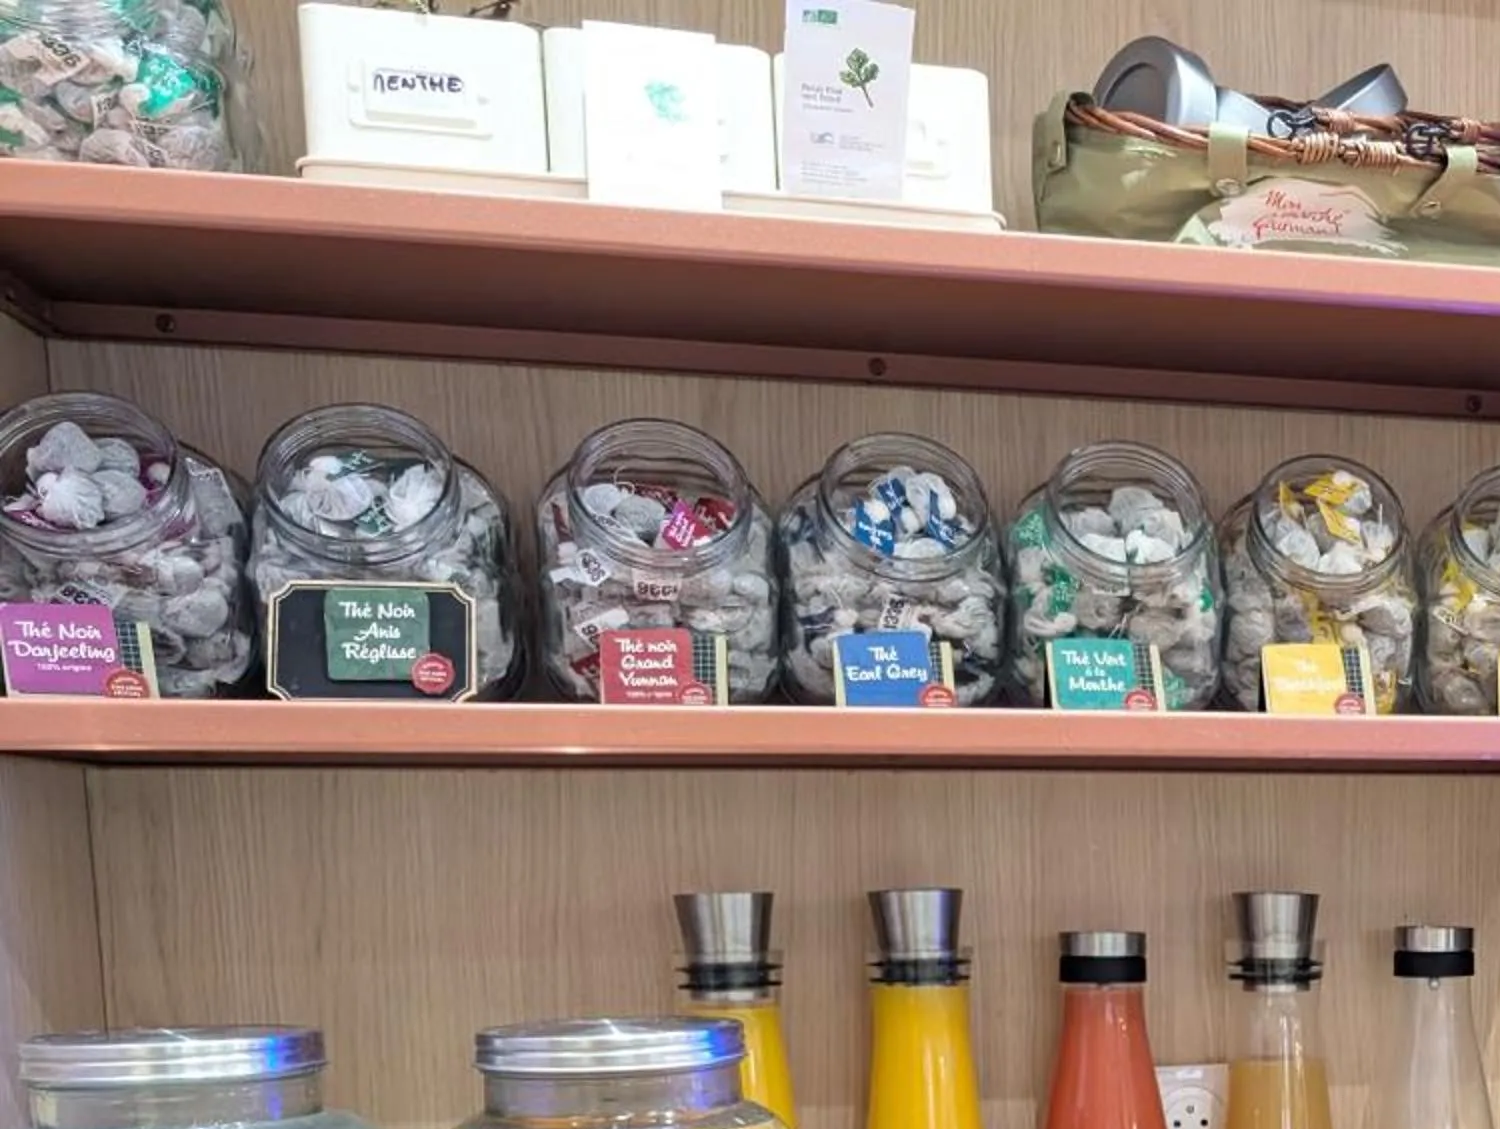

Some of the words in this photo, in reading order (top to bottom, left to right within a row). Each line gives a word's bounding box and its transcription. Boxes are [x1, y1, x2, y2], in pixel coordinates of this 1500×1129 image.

[338, 601, 373, 618] Thé
[377, 602, 416, 619] Noir
[14, 621, 53, 639] Thé
[58, 622, 102, 640] Noir
[353, 621, 401, 641] Anis
[7, 640, 116, 663] Darjeeling
[341, 641, 417, 664] Réglisse
[614, 637, 645, 653] Thé
[866, 645, 899, 661] Thé
[621, 655, 674, 670] Grand
[1093, 650, 1127, 667] Vert
[846, 665, 883, 681] Earl
[886, 663, 928, 683] Grey
[1068, 676, 1127, 693] Menthe
